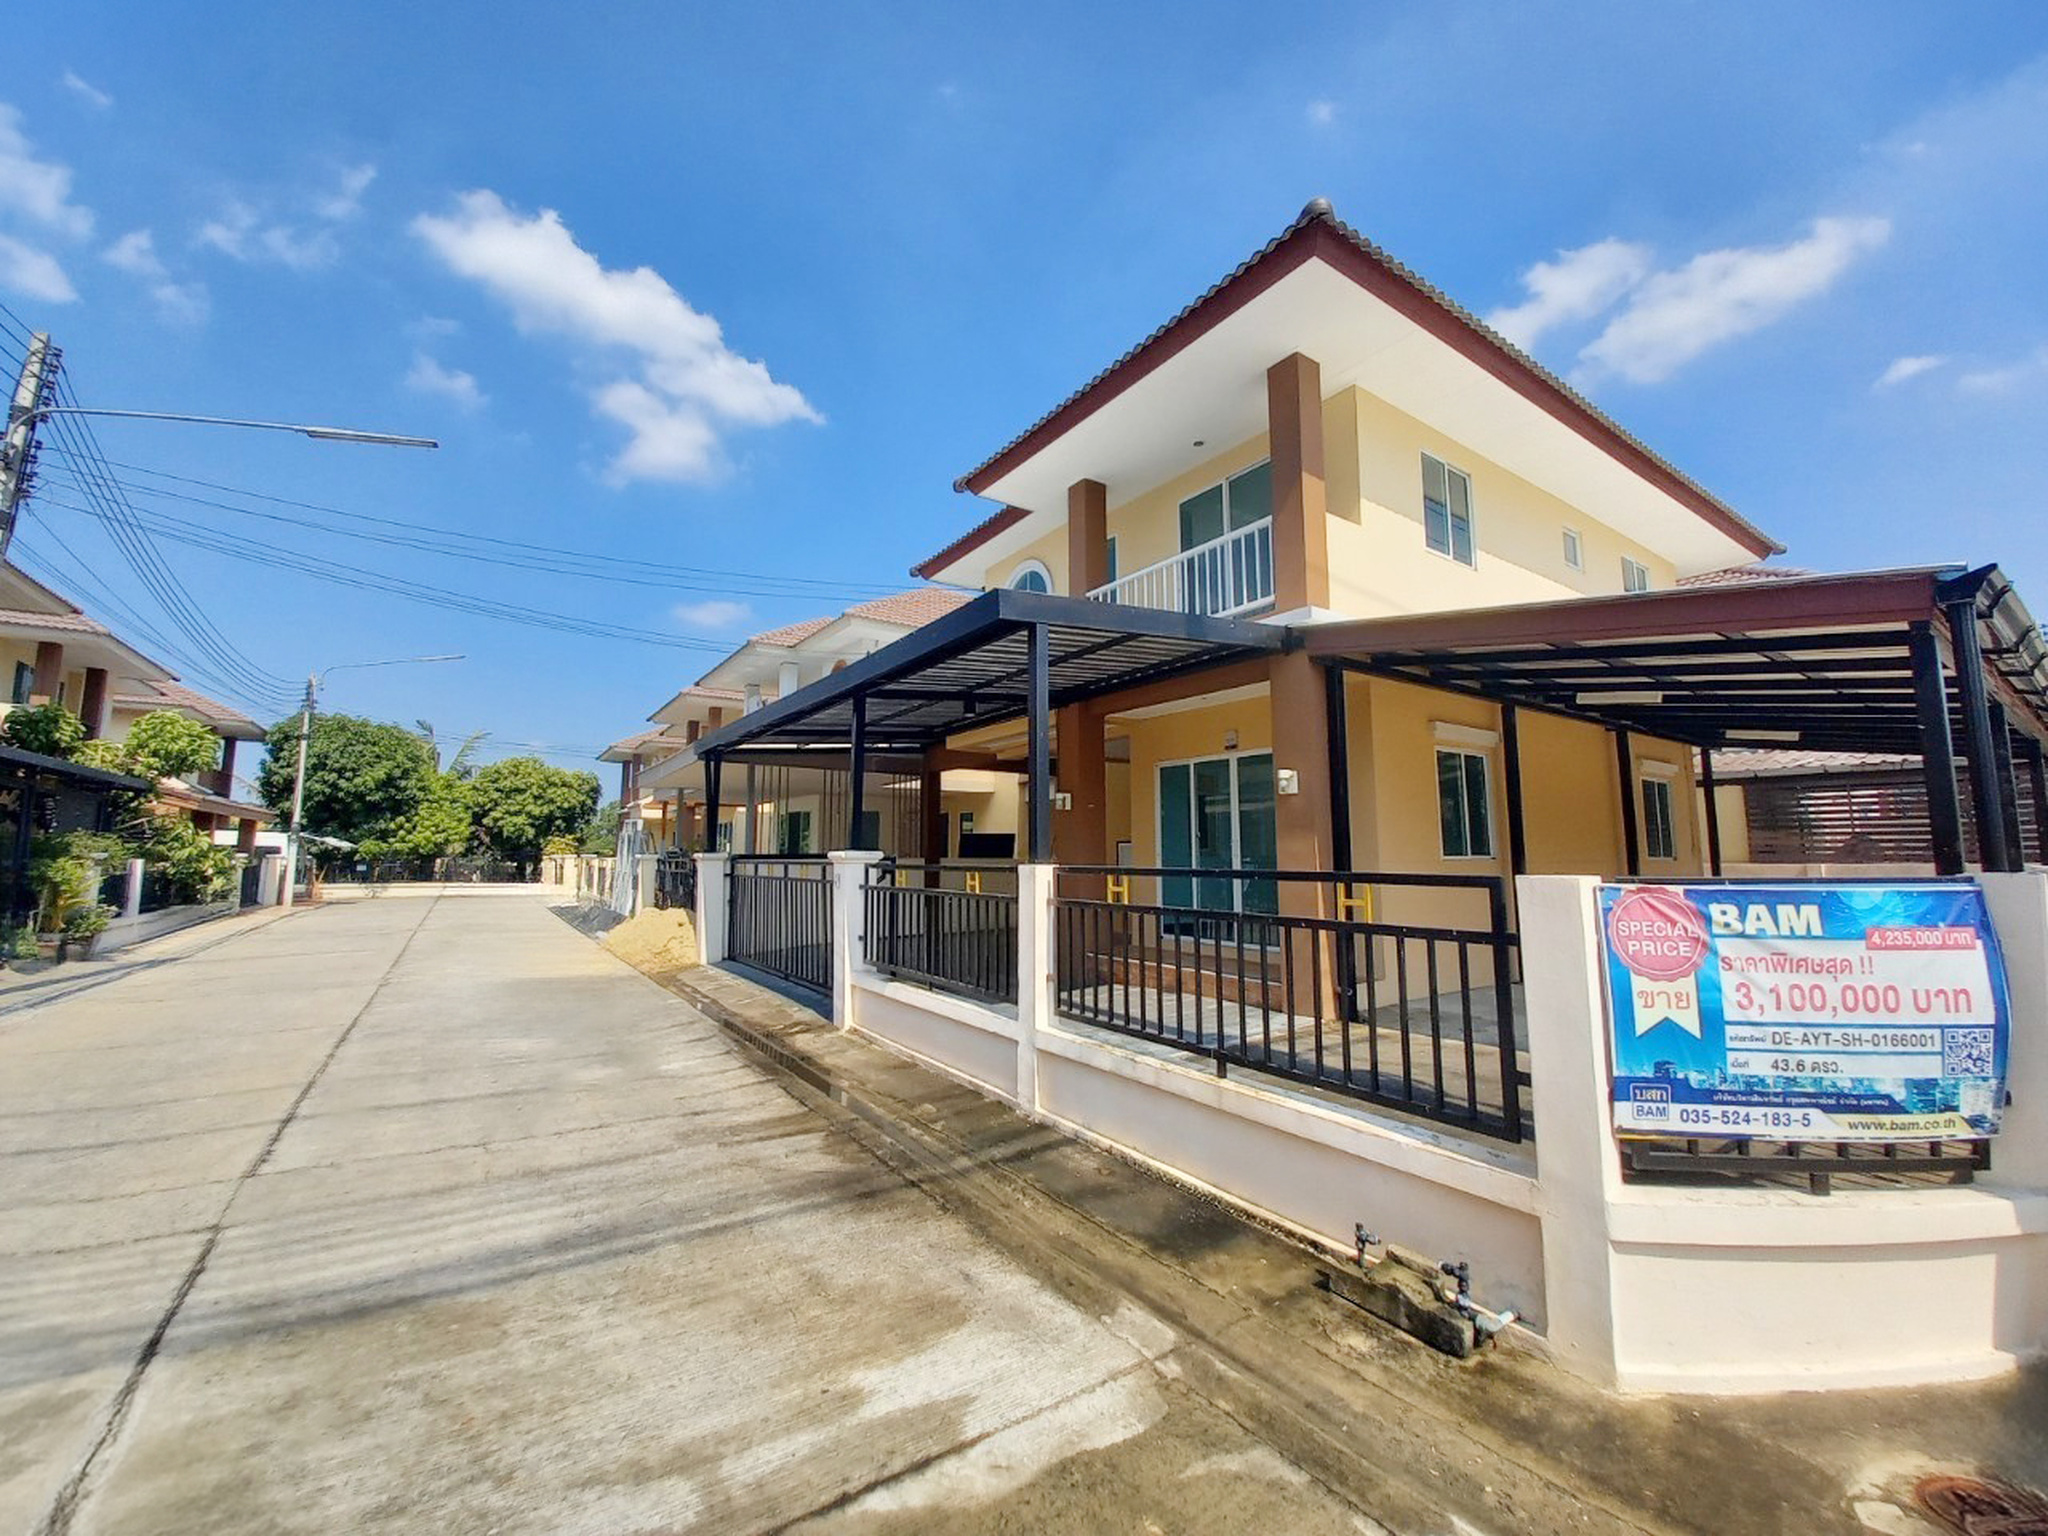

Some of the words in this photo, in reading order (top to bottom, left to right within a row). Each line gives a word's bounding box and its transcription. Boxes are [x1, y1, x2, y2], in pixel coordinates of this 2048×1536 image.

[1708, 902, 1823, 937] BAM
[1617, 920, 1699, 938] SPECIAL
[1871, 930, 1943, 946] 4,235,000
[1945, 933, 1972, 946] บาท
[1627, 940, 1692, 957] PRICE
[1721, 951, 1853, 983] ราคาพิเศษสุด
[1859, 956, 1875, 976] !!
[1637, 990, 1691, 1010] ขาย
[1735, 981, 1901, 1018] 3,100,000
[1912, 987, 1973, 1014] บาท
[1771, 1031, 1936, 1049] DE-AYT-SH-0166001
[1770, 1058, 1806, 1073] 43.6
[1635, 1105, 1667, 1118] BAM
[1680, 1108, 1811, 1127] 035-524-183-5
[1848, 1118, 1957, 1131] www.bam.co.th
